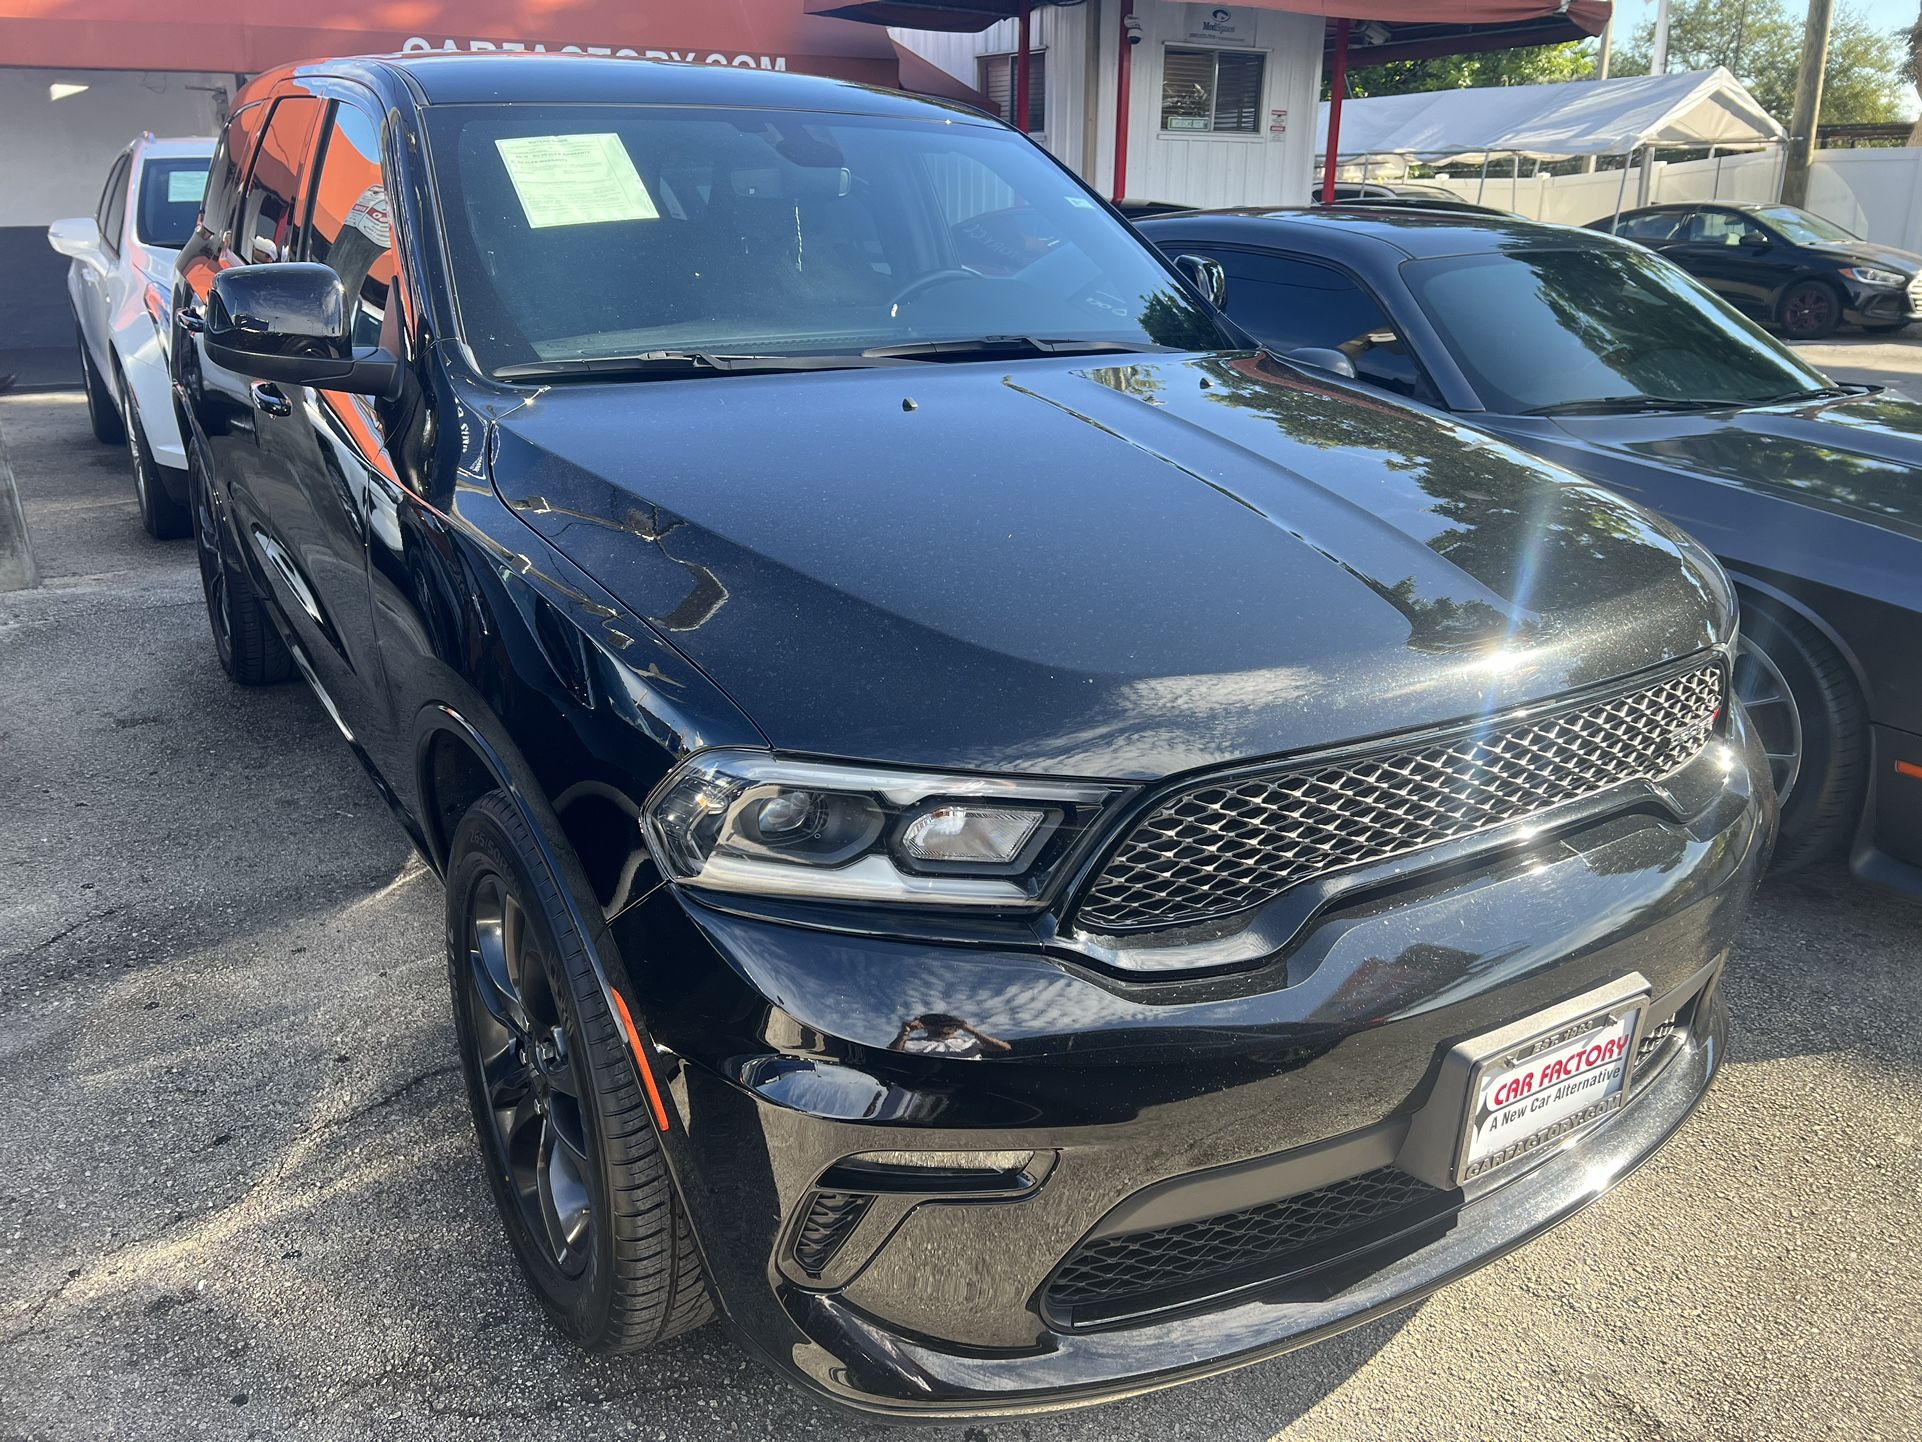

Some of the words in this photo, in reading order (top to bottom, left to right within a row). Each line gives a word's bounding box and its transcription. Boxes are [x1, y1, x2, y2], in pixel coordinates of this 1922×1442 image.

[1489, 1117, 1498, 1132] A
[1501, 1106, 1526, 1127] New
[1530, 1096, 1551, 1112] Car
[1553, 1067, 1620, 1102] Alternative
[1494, 1072, 1534, 1106] CAR
[1538, 1034, 1630, 1088] FACTORY
[1464, 1093, 1622, 1180] CARFACTORY.COM
